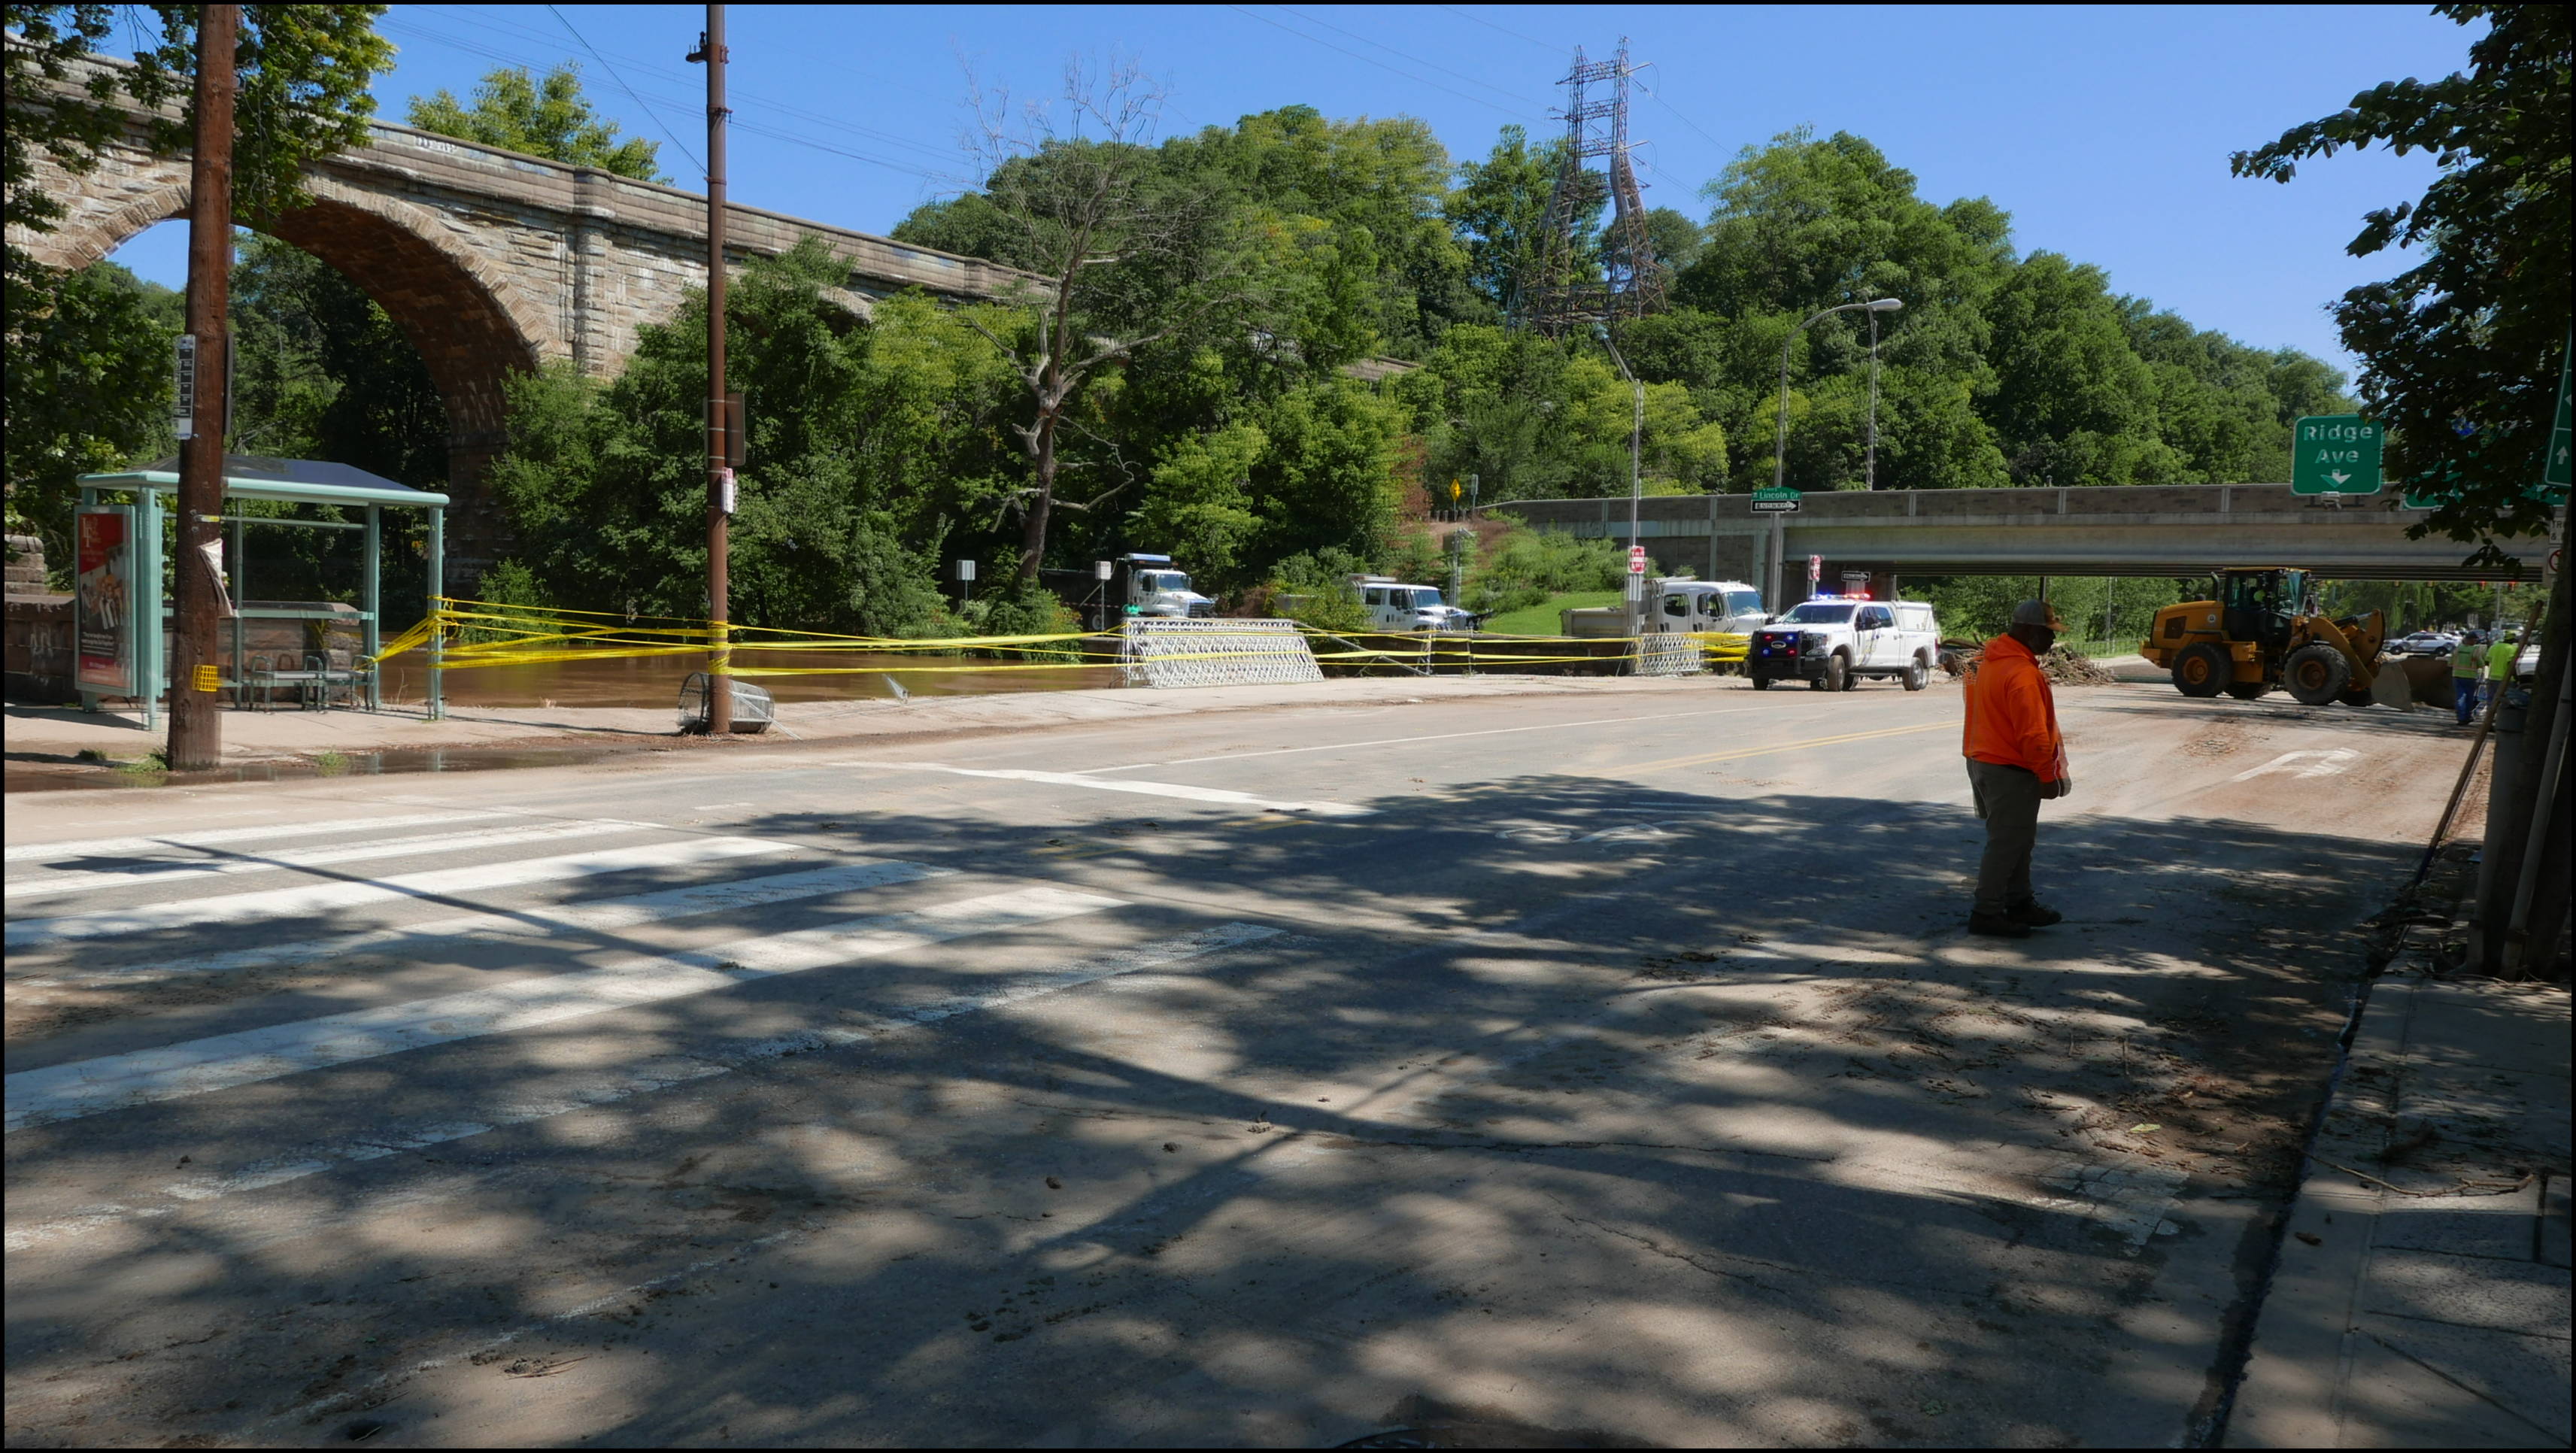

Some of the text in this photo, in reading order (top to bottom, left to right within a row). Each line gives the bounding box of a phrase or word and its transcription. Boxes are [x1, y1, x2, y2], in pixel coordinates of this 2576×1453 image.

[2304, 424, 2373, 443] Ridge
[2315, 449, 2359, 463] Ave
[1759, 491, 1788, 499] Lincoln
